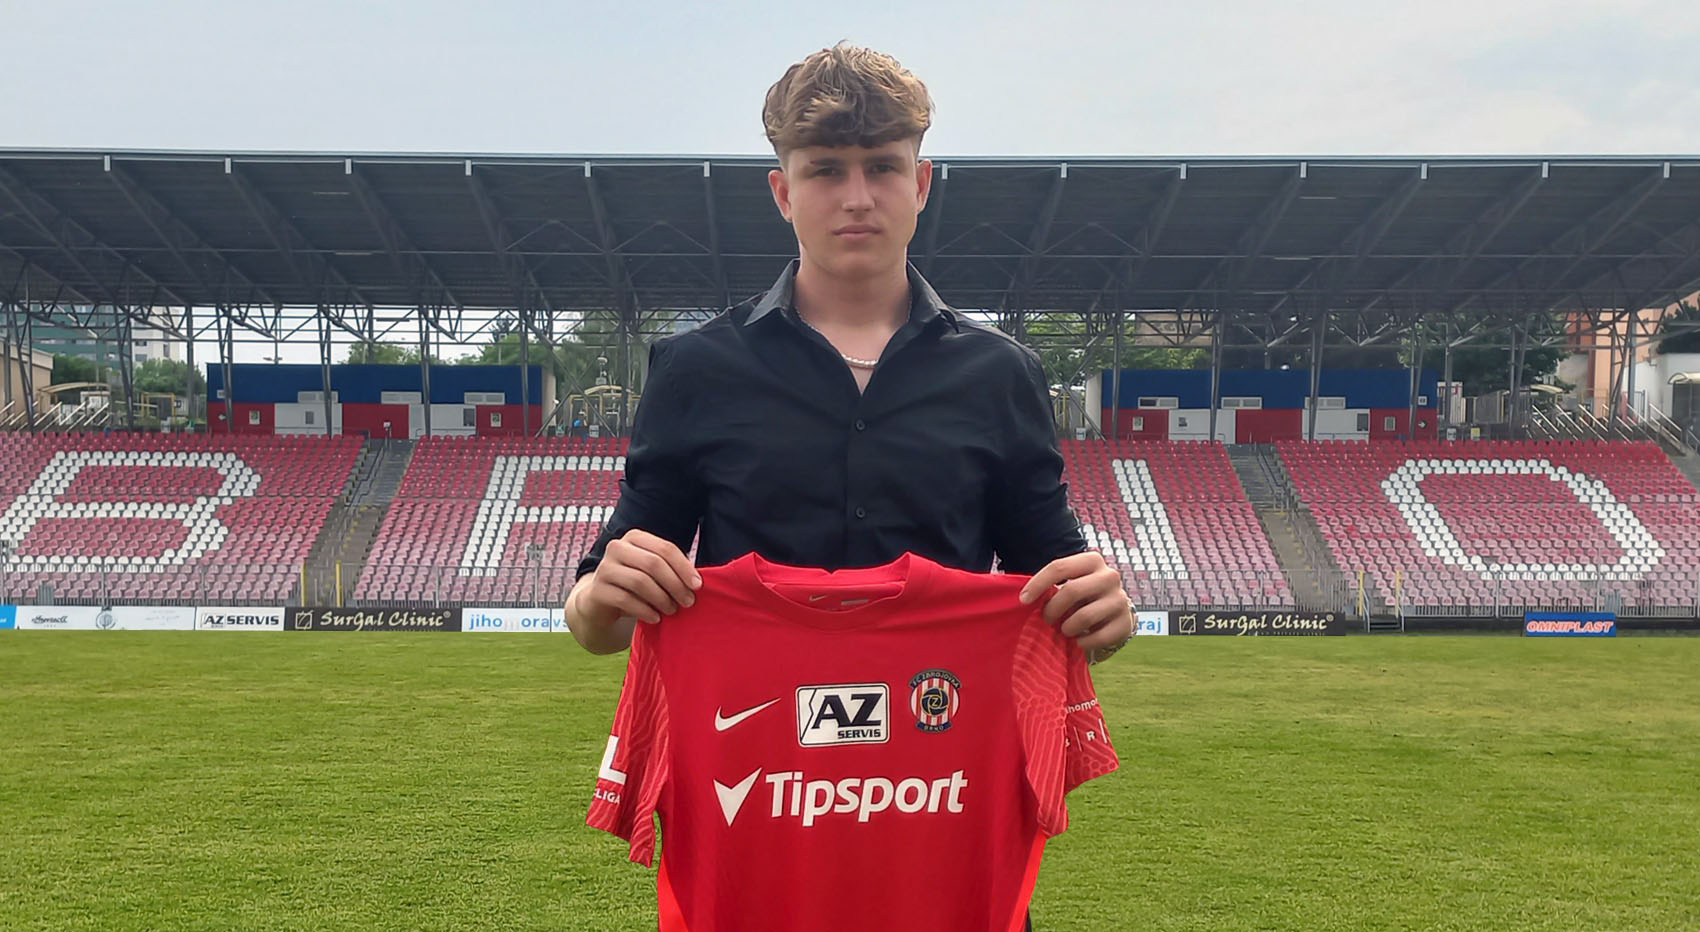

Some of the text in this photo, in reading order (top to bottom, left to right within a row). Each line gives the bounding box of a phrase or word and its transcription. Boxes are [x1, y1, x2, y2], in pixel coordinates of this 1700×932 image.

[205, 615, 280, 626] AZ SERVIS
[1136, 616, 1161, 634] raj
[1527, 621, 1614, 633] OMNIPLAST
[812, 693, 883, 729] AZ
[837, 728, 882, 740] SERVIS
[765, 769, 969, 828] Tipsport
